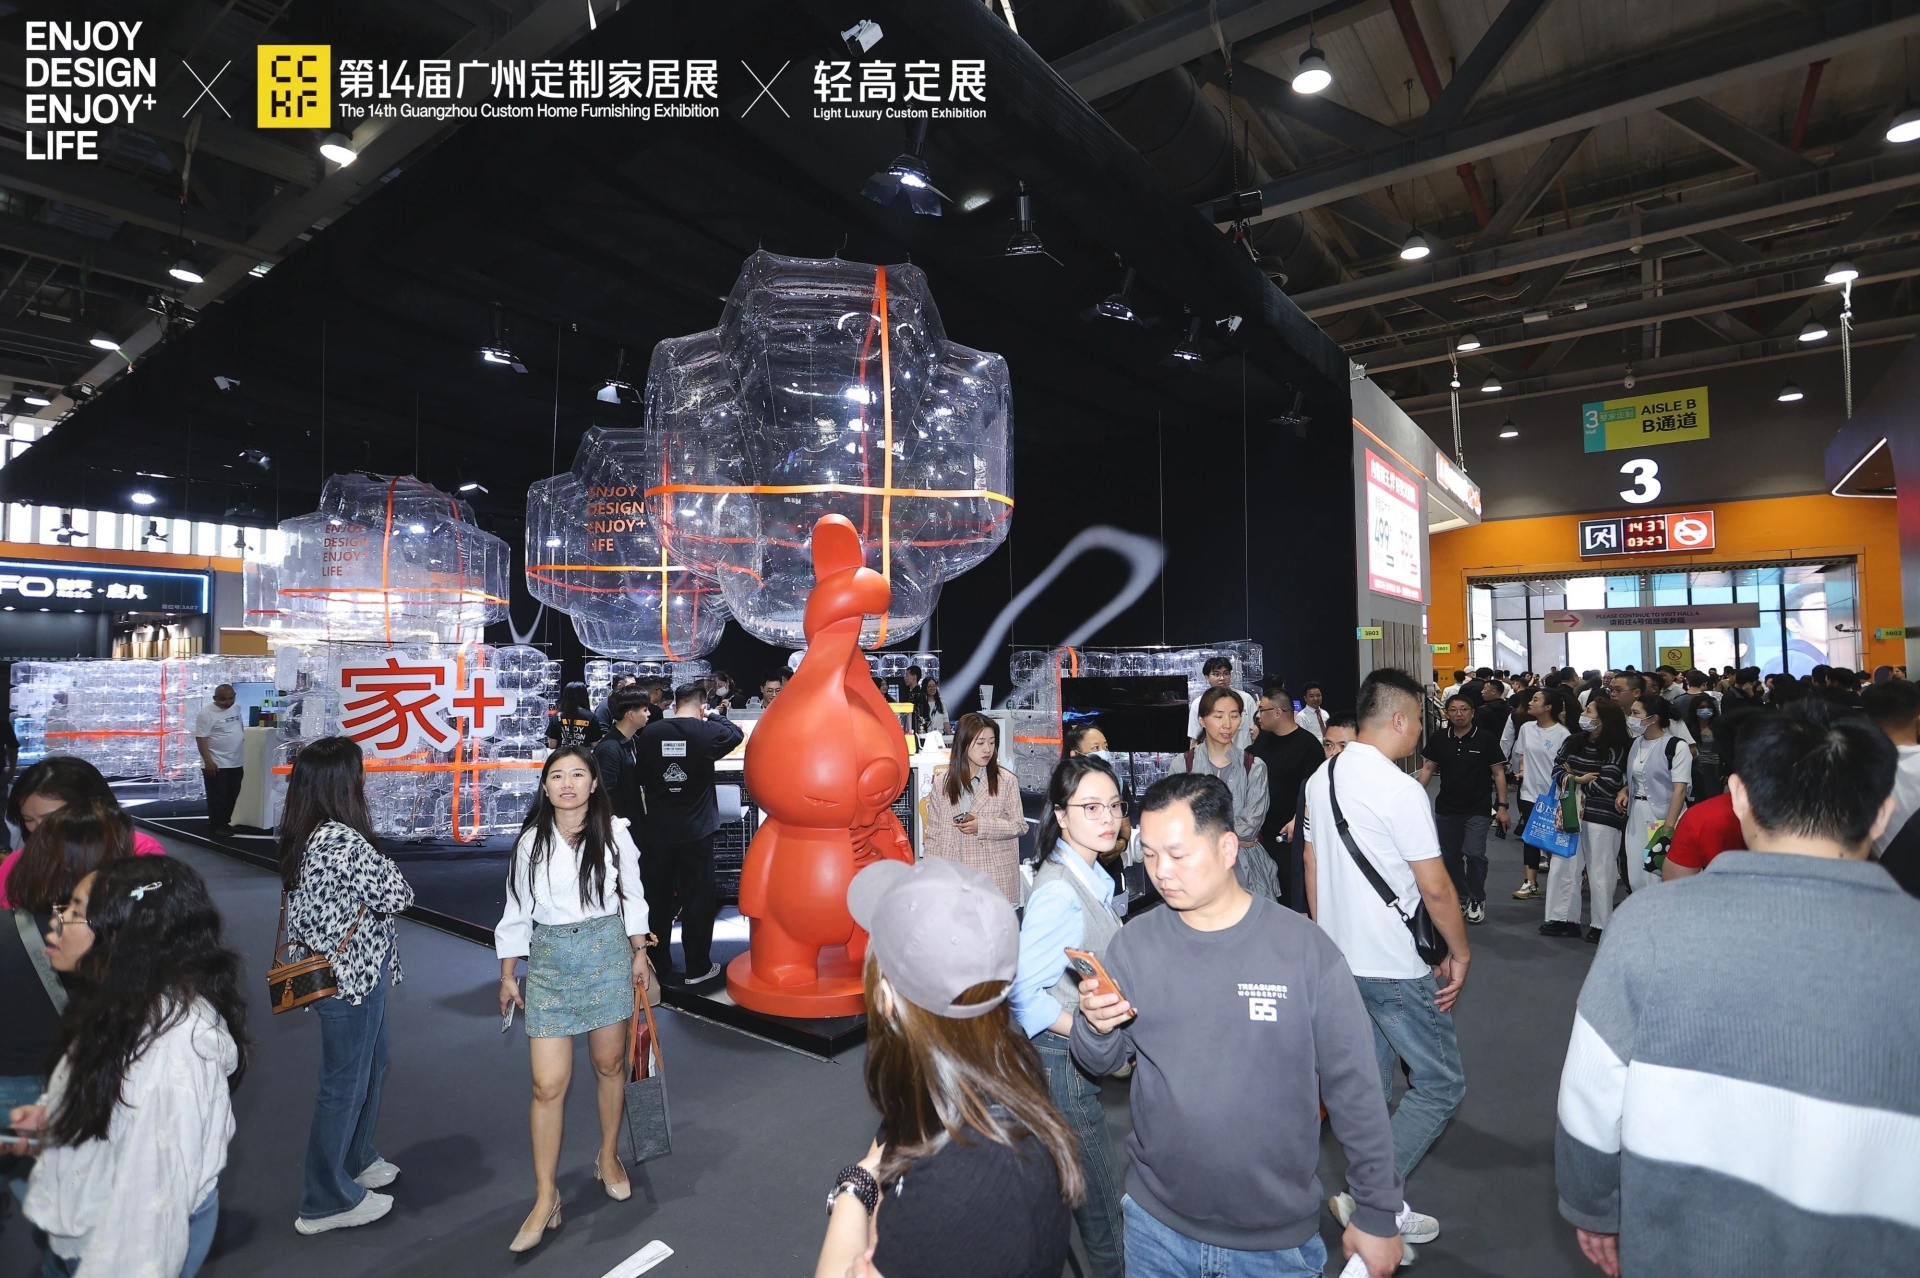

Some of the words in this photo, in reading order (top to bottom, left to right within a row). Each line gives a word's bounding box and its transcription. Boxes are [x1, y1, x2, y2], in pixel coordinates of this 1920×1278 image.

[1641, 401, 1682, 415] AISLE
[1686, 399, 1697, 410] B
[1585, 410, 1599, 428] 3
[1642, 412, 1698, 434] B通道
[1619, 458, 1662, 504] 3
[587, 486, 639, 499] ENJOY
[587, 501, 645, 516] DESIGN
[325, 524, 366, 534] ENJOY
[324, 537, 370, 548] DESIGN
[587, 538, 615, 552] LIFE
[1627, 535, 1663, 547] 03-27
[322, 566, 343, 577] LIFE
[1609, 617, 1686, 626] 请前往4号馆继续参观
[1236, 983, 1288, 993] TREASURES
[1237, 990, 1288, 999] WONDERFUL
